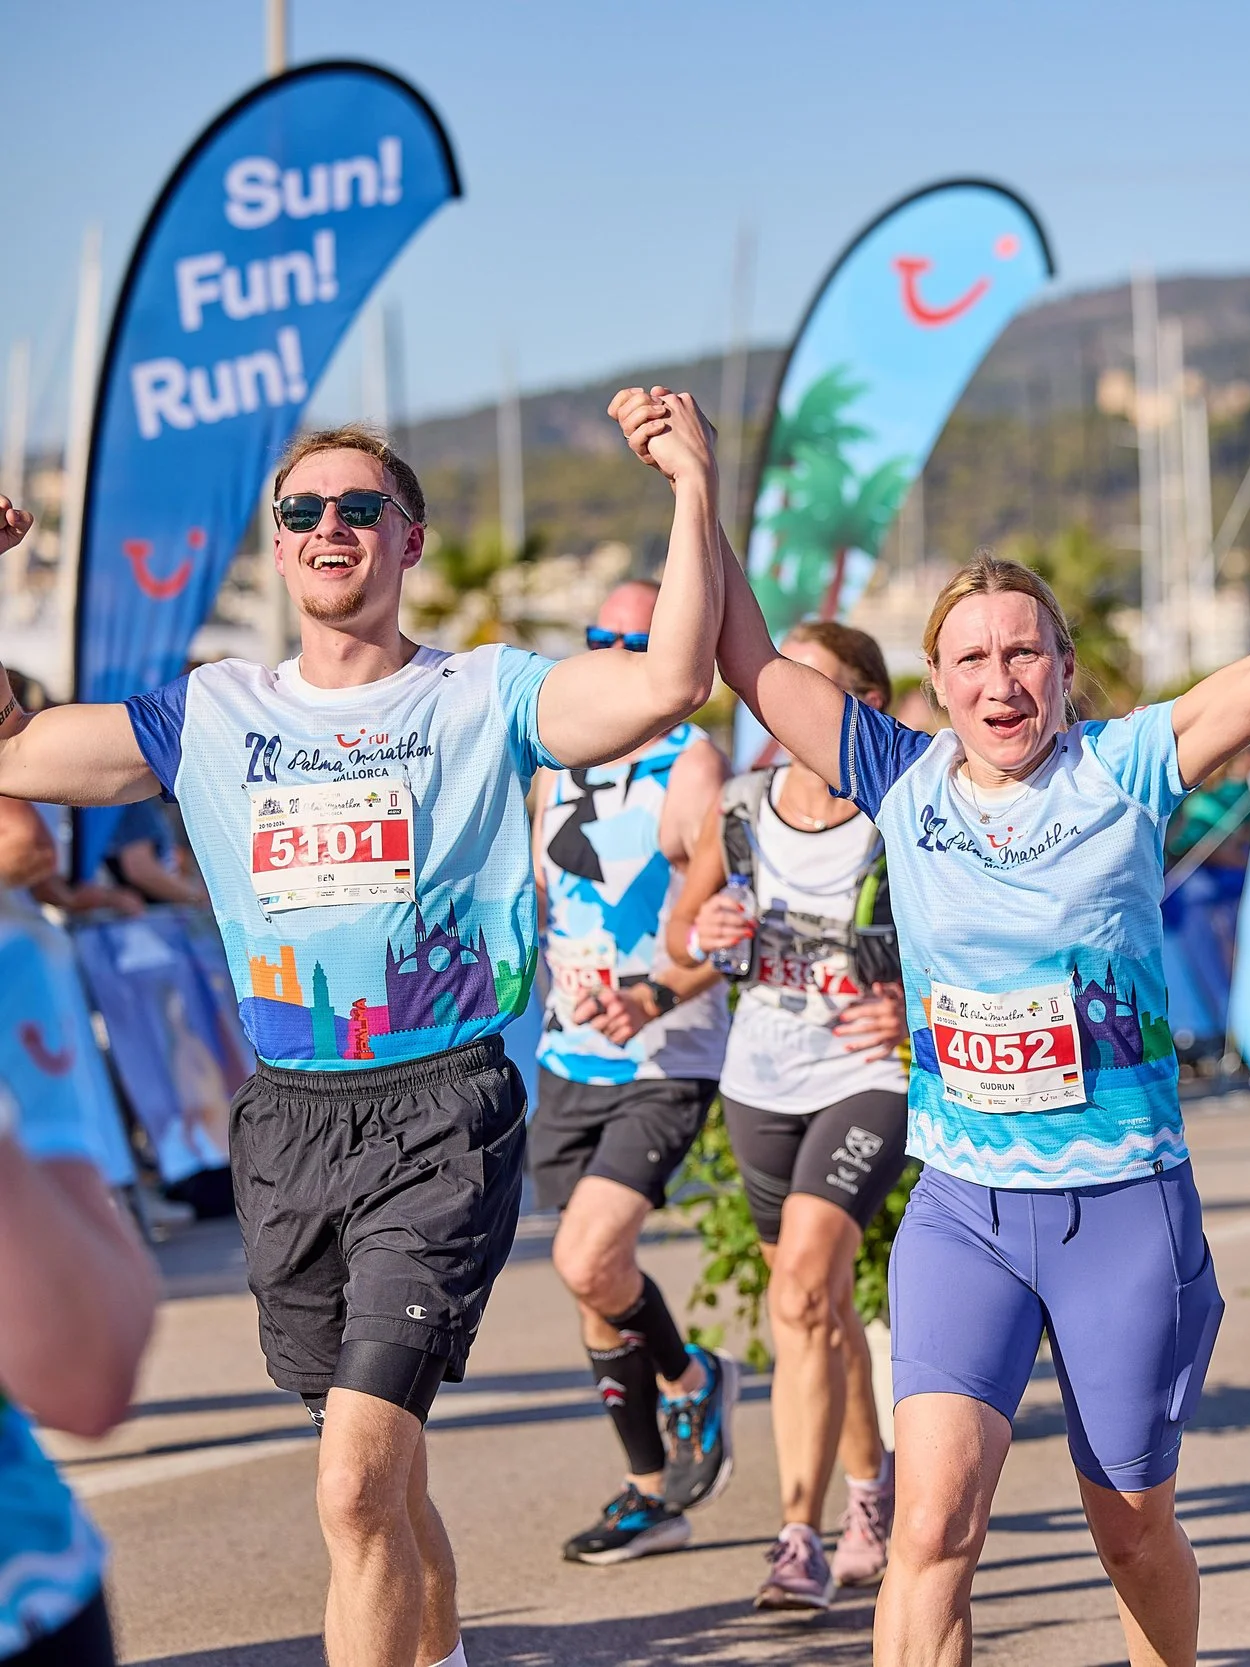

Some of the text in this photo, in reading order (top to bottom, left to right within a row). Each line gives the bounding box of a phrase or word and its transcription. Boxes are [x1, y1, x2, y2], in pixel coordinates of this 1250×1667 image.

[223, 136, 402, 230] Sun!
[175, 229, 338, 333] Fun!
[131, 325, 307, 439] Run!
[245, 731, 282, 784] 20
[287, 748, 346, 773] Palma
[368, 733, 389, 745] TUI
[269, 821, 384, 868] 5101
[945, 831, 996, 864] Palma
[317, 873, 335, 883] BEN
[989, 1009, 1025, 1022] Marathon
[947, 1030, 1057, 1072] 4052
[980, 1082, 1016, 1091] GUDRUN
